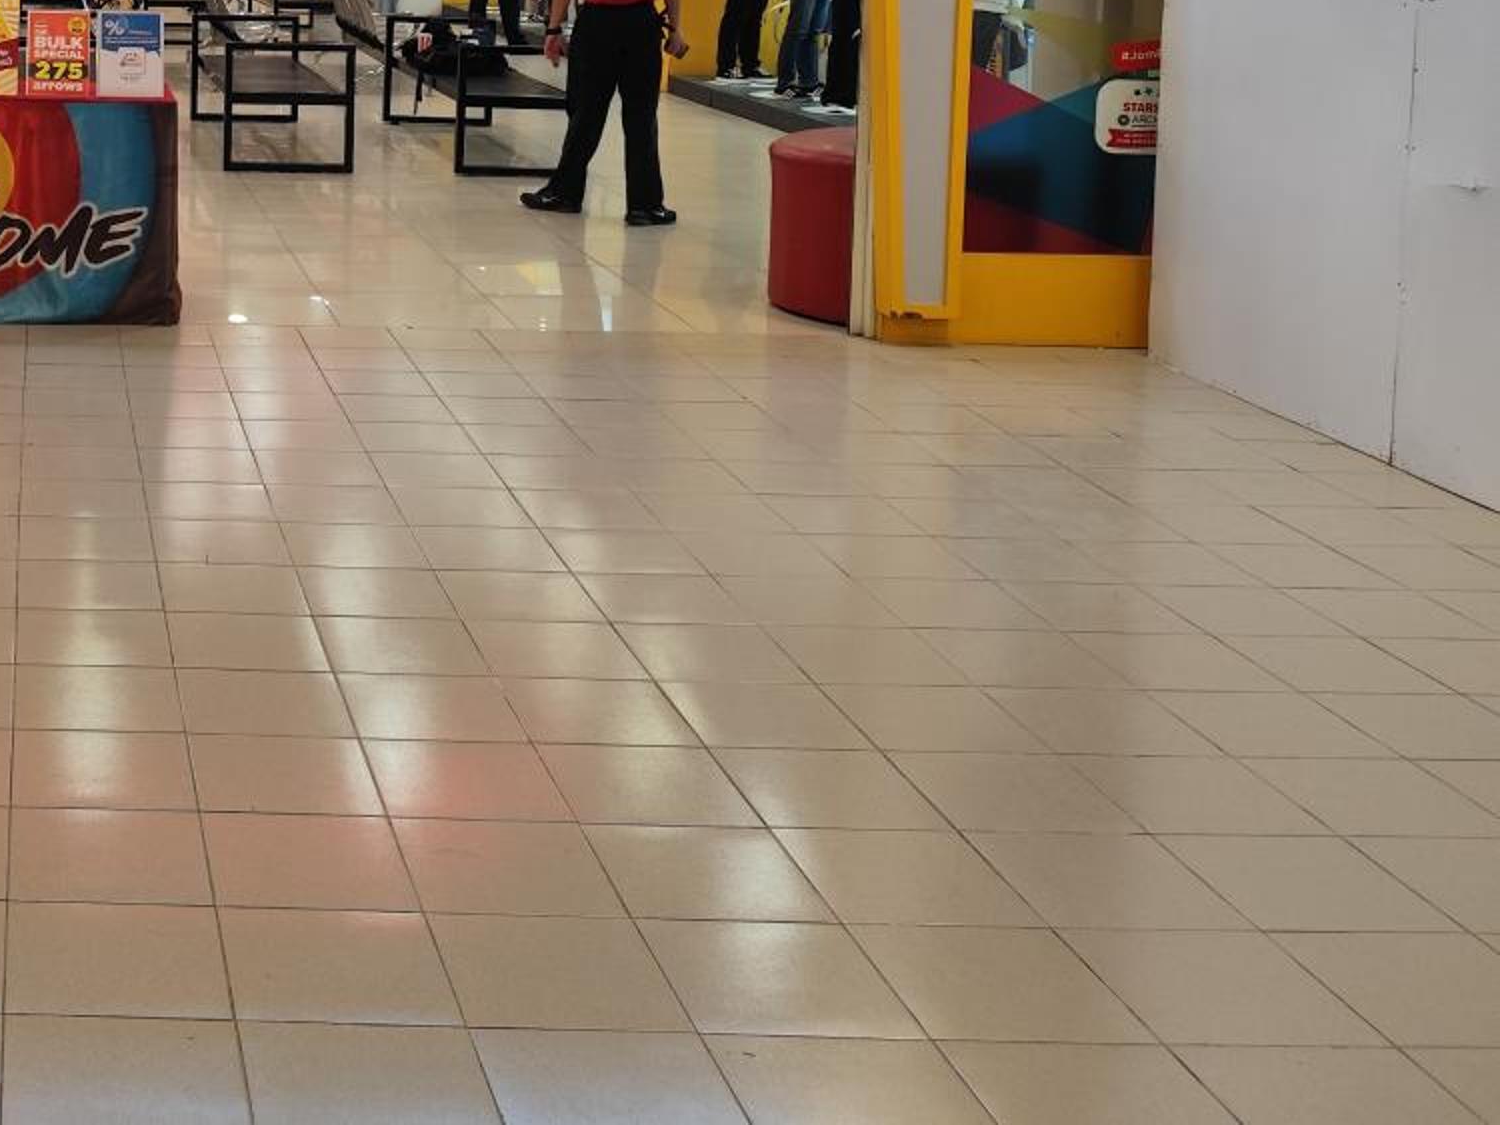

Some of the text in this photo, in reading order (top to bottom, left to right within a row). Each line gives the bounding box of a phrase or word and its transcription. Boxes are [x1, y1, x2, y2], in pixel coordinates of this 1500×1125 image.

[35, 35, 85, 50] BULK
[34, 49, 86, 61] SPECIAL
[35, 60, 84, 81] 275
[1131, 116, 1157, 125] ARC
